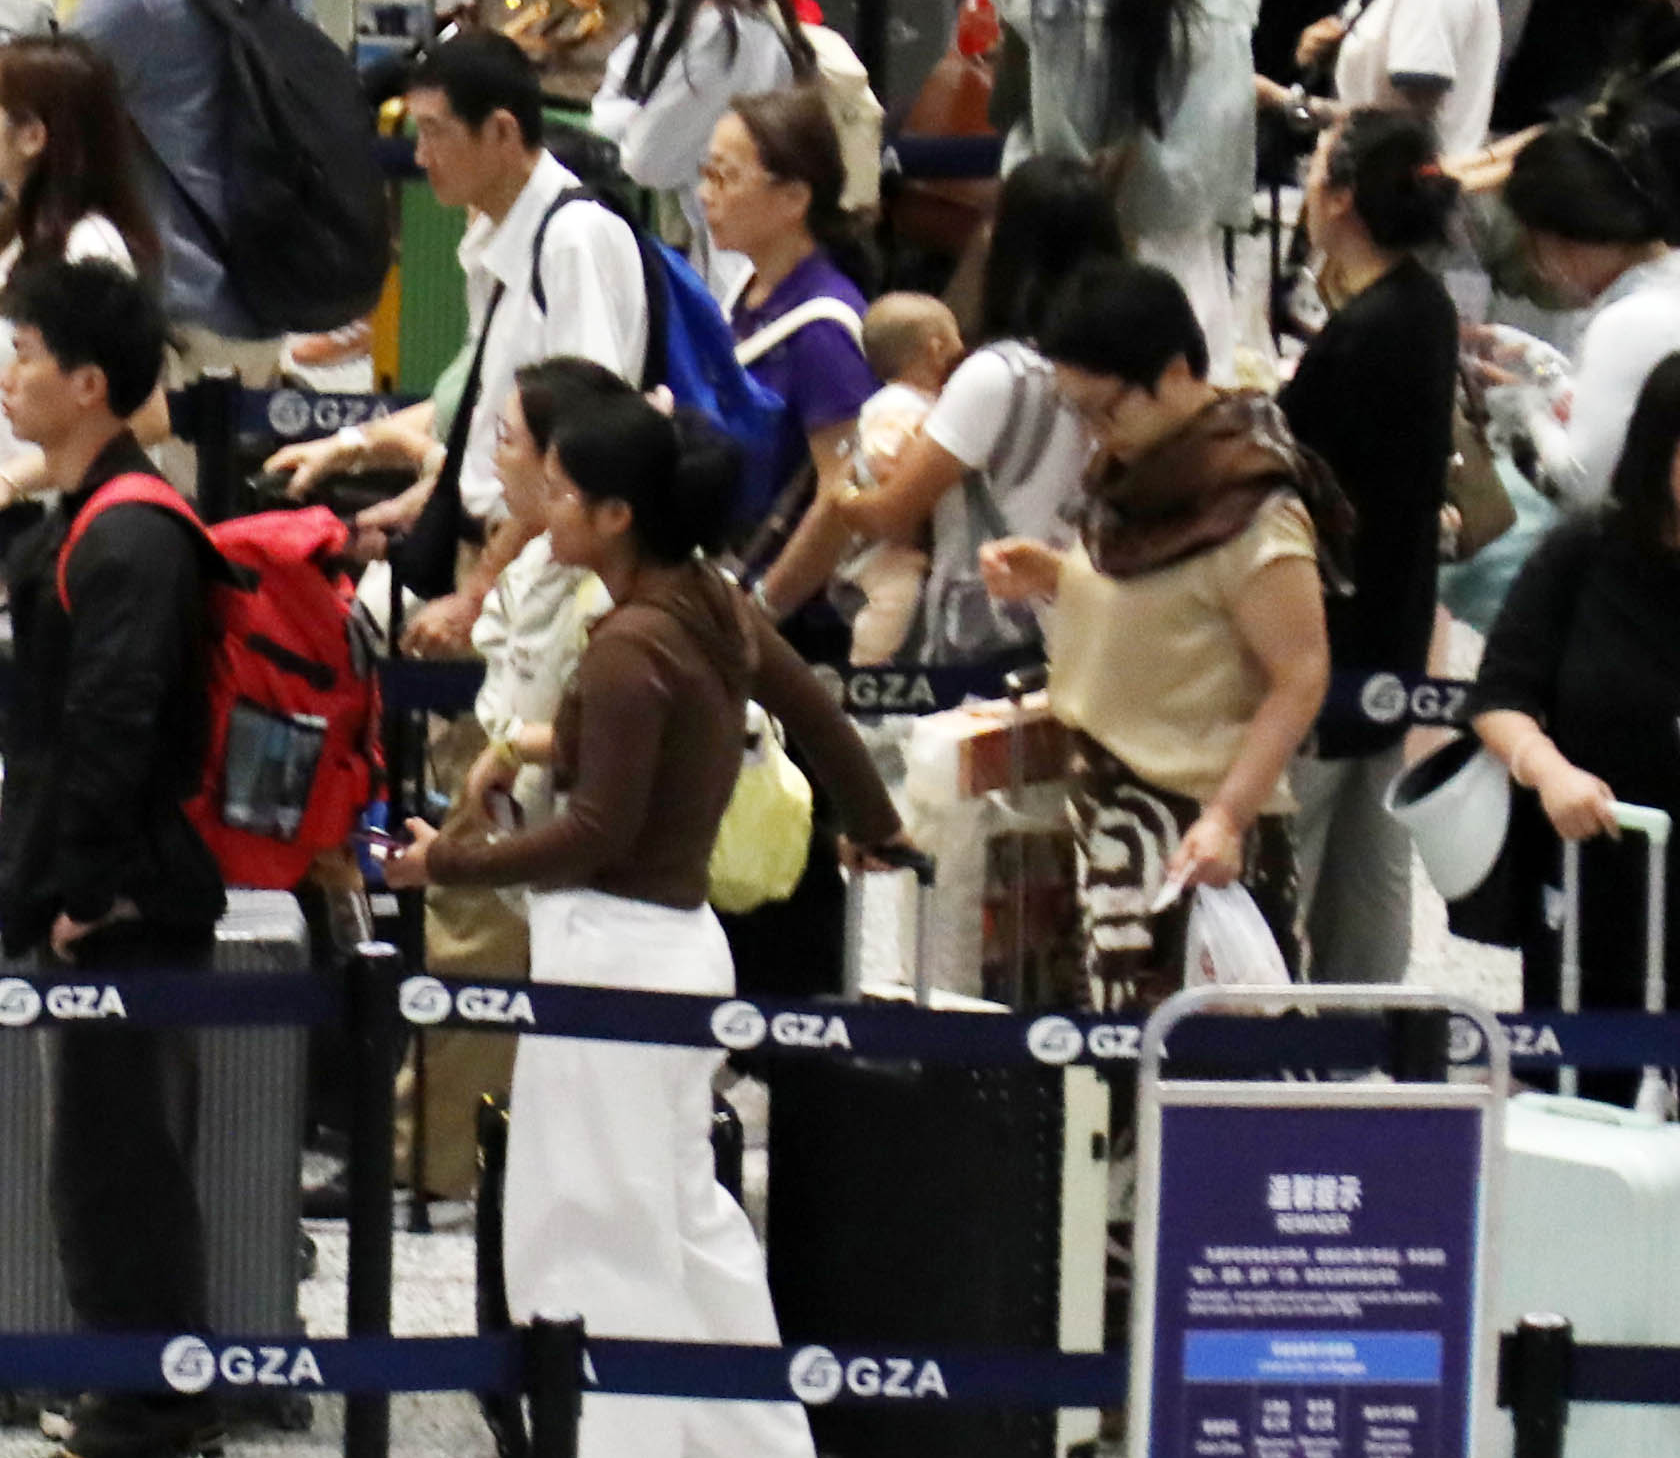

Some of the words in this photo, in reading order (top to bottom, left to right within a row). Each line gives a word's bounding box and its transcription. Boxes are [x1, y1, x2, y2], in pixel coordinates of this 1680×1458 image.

[847, 673, 937, 710] GZA
[1410, 685, 1466, 721] GZ
[46, 985, 127, 1019] GZA
[455, 987, 536, 1024] GZA
[771, 1012, 851, 1049] GZA
[1088, 1024, 1168, 1059] GZ
[1267, 1174, 1363, 1212] 温馨提示
[220, 1347, 324, 1385] GZA
[845, 1357, 948, 1398] GZA
